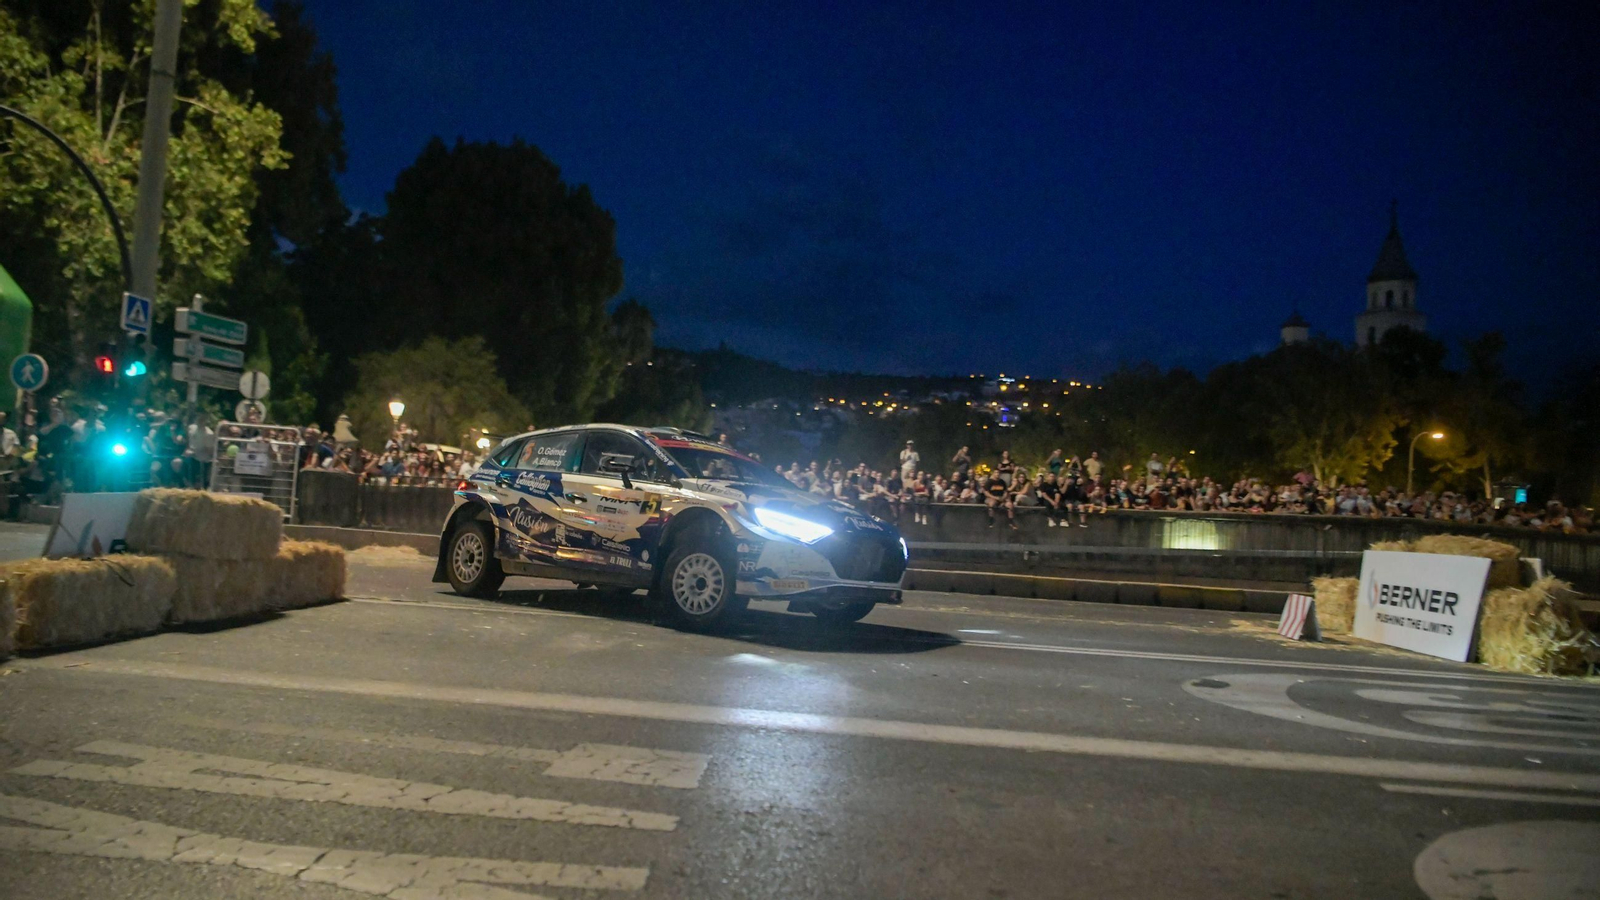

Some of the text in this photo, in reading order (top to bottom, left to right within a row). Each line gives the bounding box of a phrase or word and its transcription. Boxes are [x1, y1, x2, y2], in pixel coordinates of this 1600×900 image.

[645, 494, 658, 515] 5
[510, 506, 550, 533] Ilusión
[1379, 584, 1459, 616] BERNER
[1376, 612, 1454, 636] PUSHING THE LIMITS
